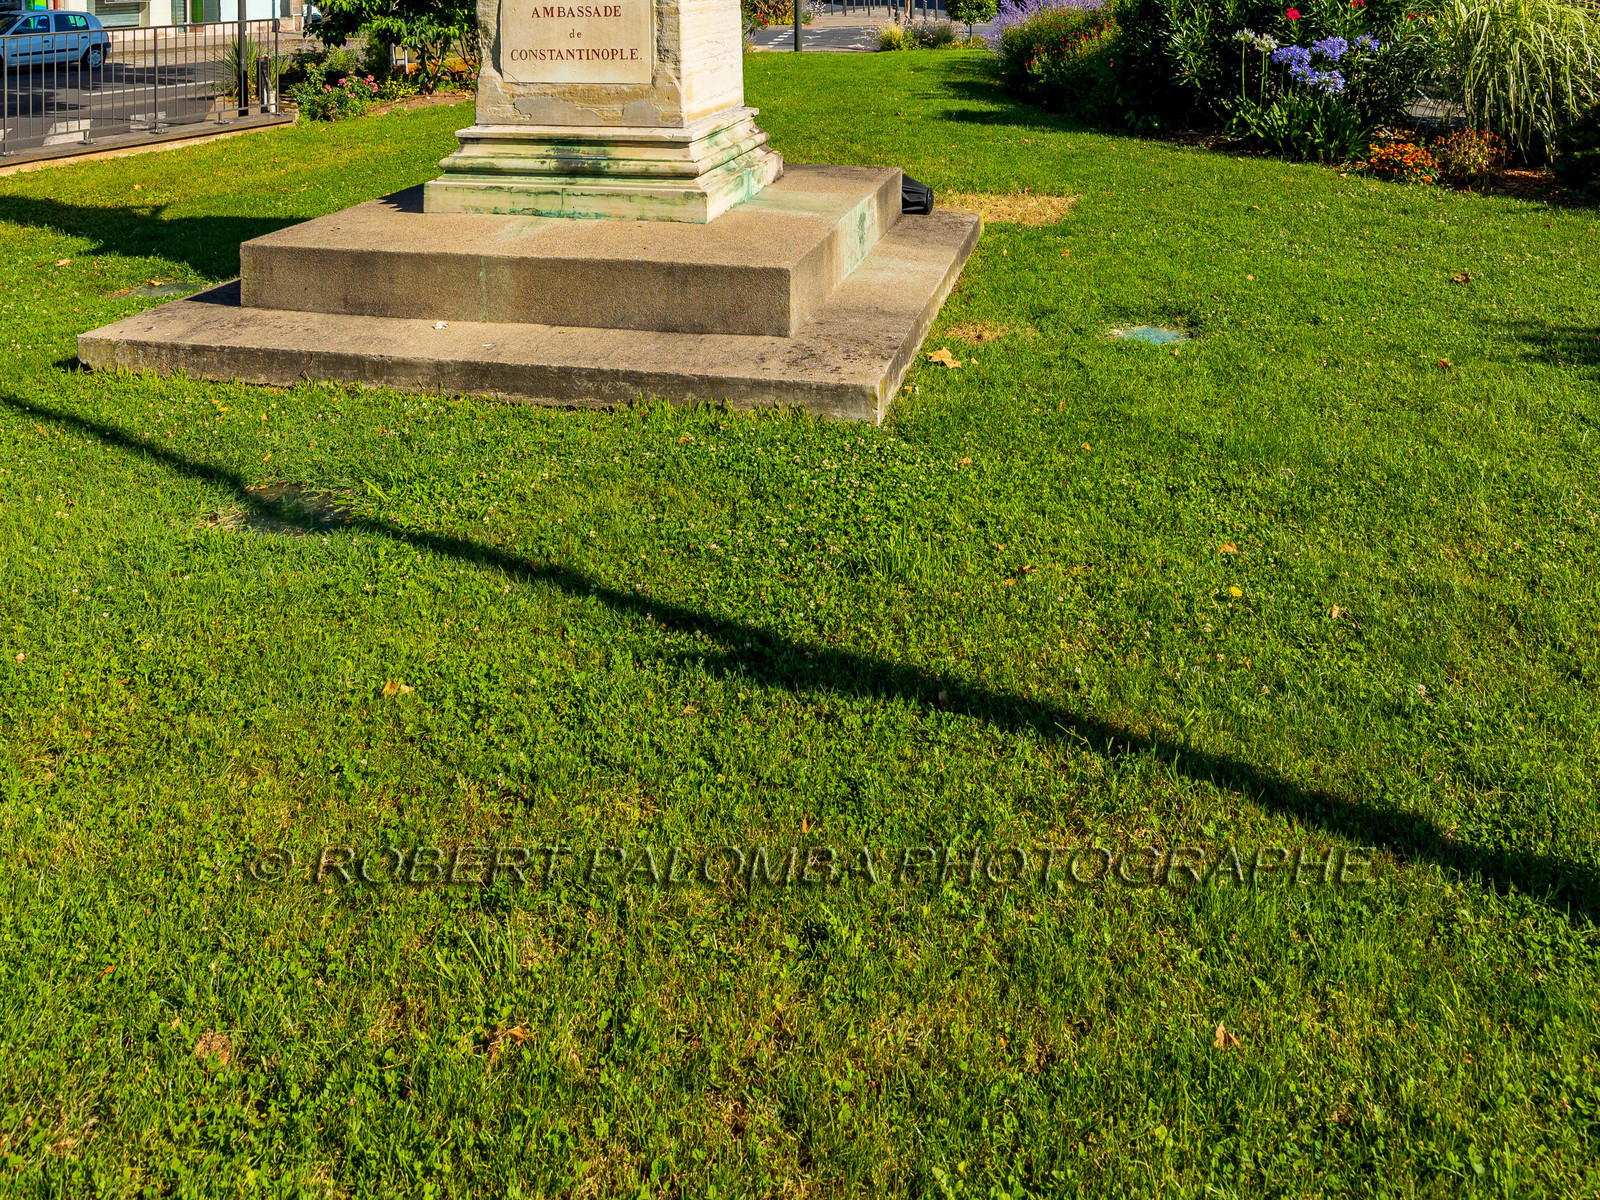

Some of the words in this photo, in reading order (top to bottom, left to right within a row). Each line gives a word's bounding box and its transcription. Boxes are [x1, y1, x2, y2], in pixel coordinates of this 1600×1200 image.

[531, 5, 622, 19] AMBASSADE
[569, 28, 582, 39] de
[510, 48, 643, 62] CONSTANTINOPLE.
